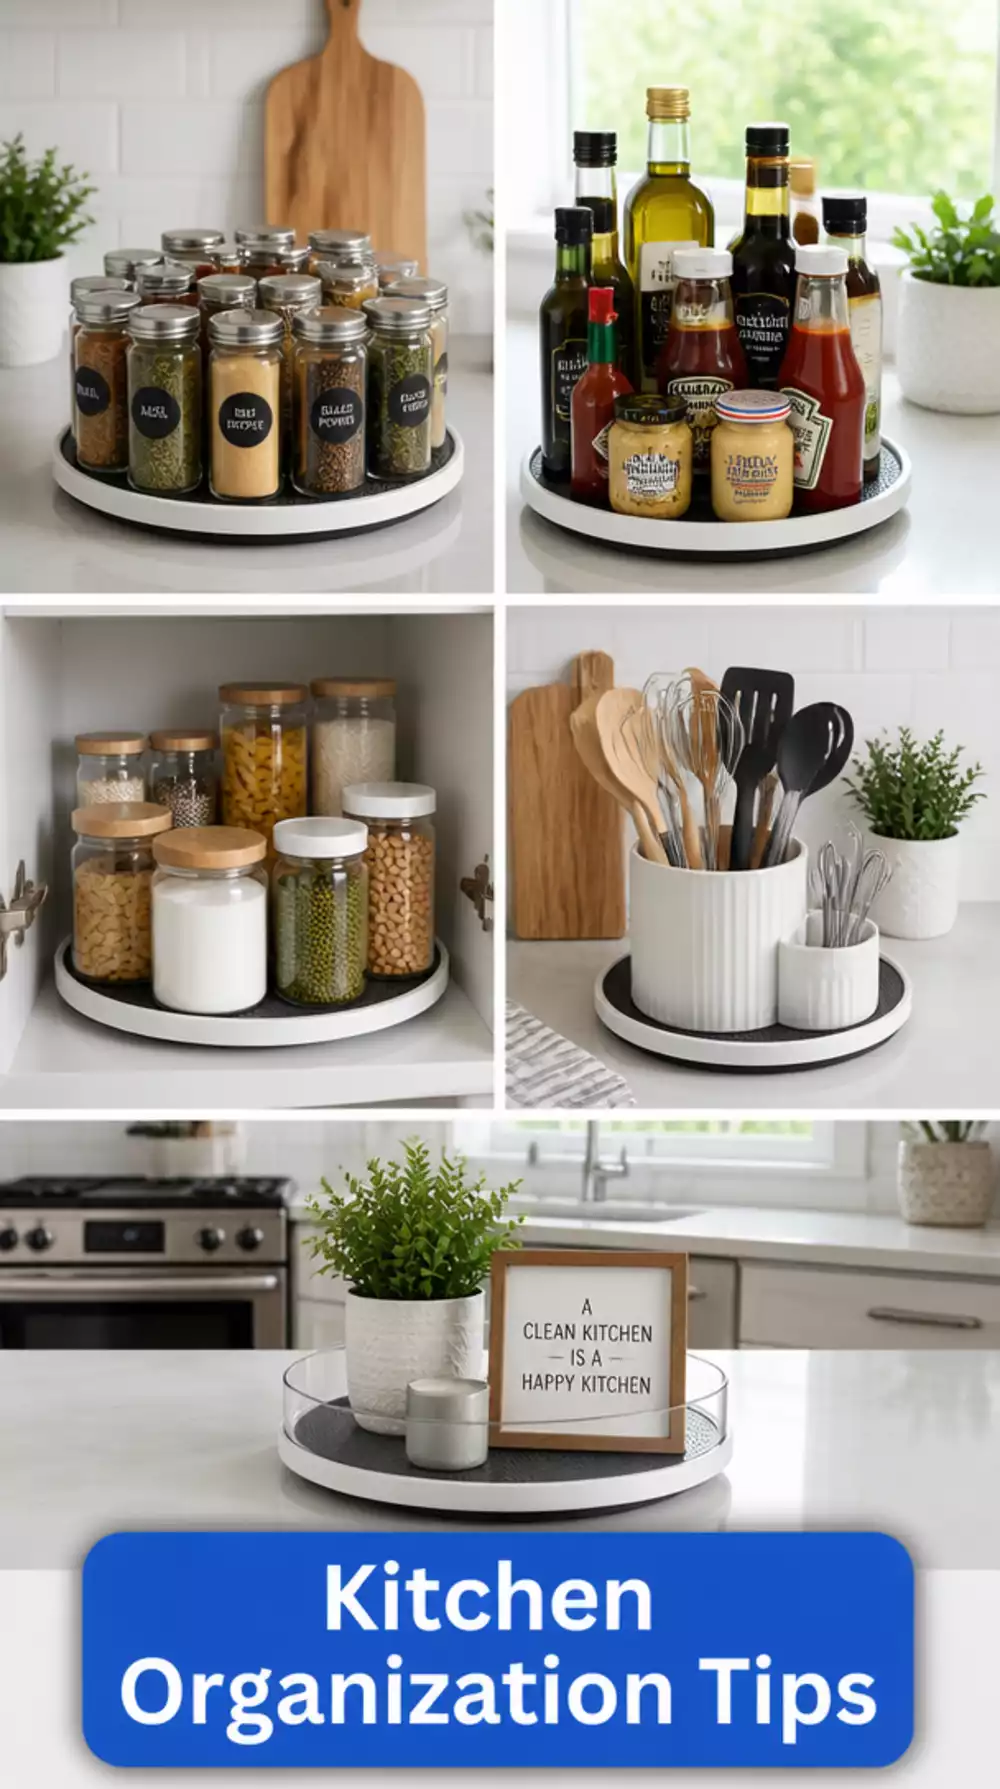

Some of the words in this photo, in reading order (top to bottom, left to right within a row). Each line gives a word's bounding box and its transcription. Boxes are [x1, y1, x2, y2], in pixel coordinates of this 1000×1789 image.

[581, 1298, 593, 1316] A
[523, 1321, 576, 1341] CLEAN
[582, 1324, 653, 1343] KITCHEN
[570, 1348, 586, 1367] IS
[591, 1349, 603, 1367] A
[522, 1373, 576, 1392] HAPPY
[581, 1375, 651, 1395] KITCHEN
